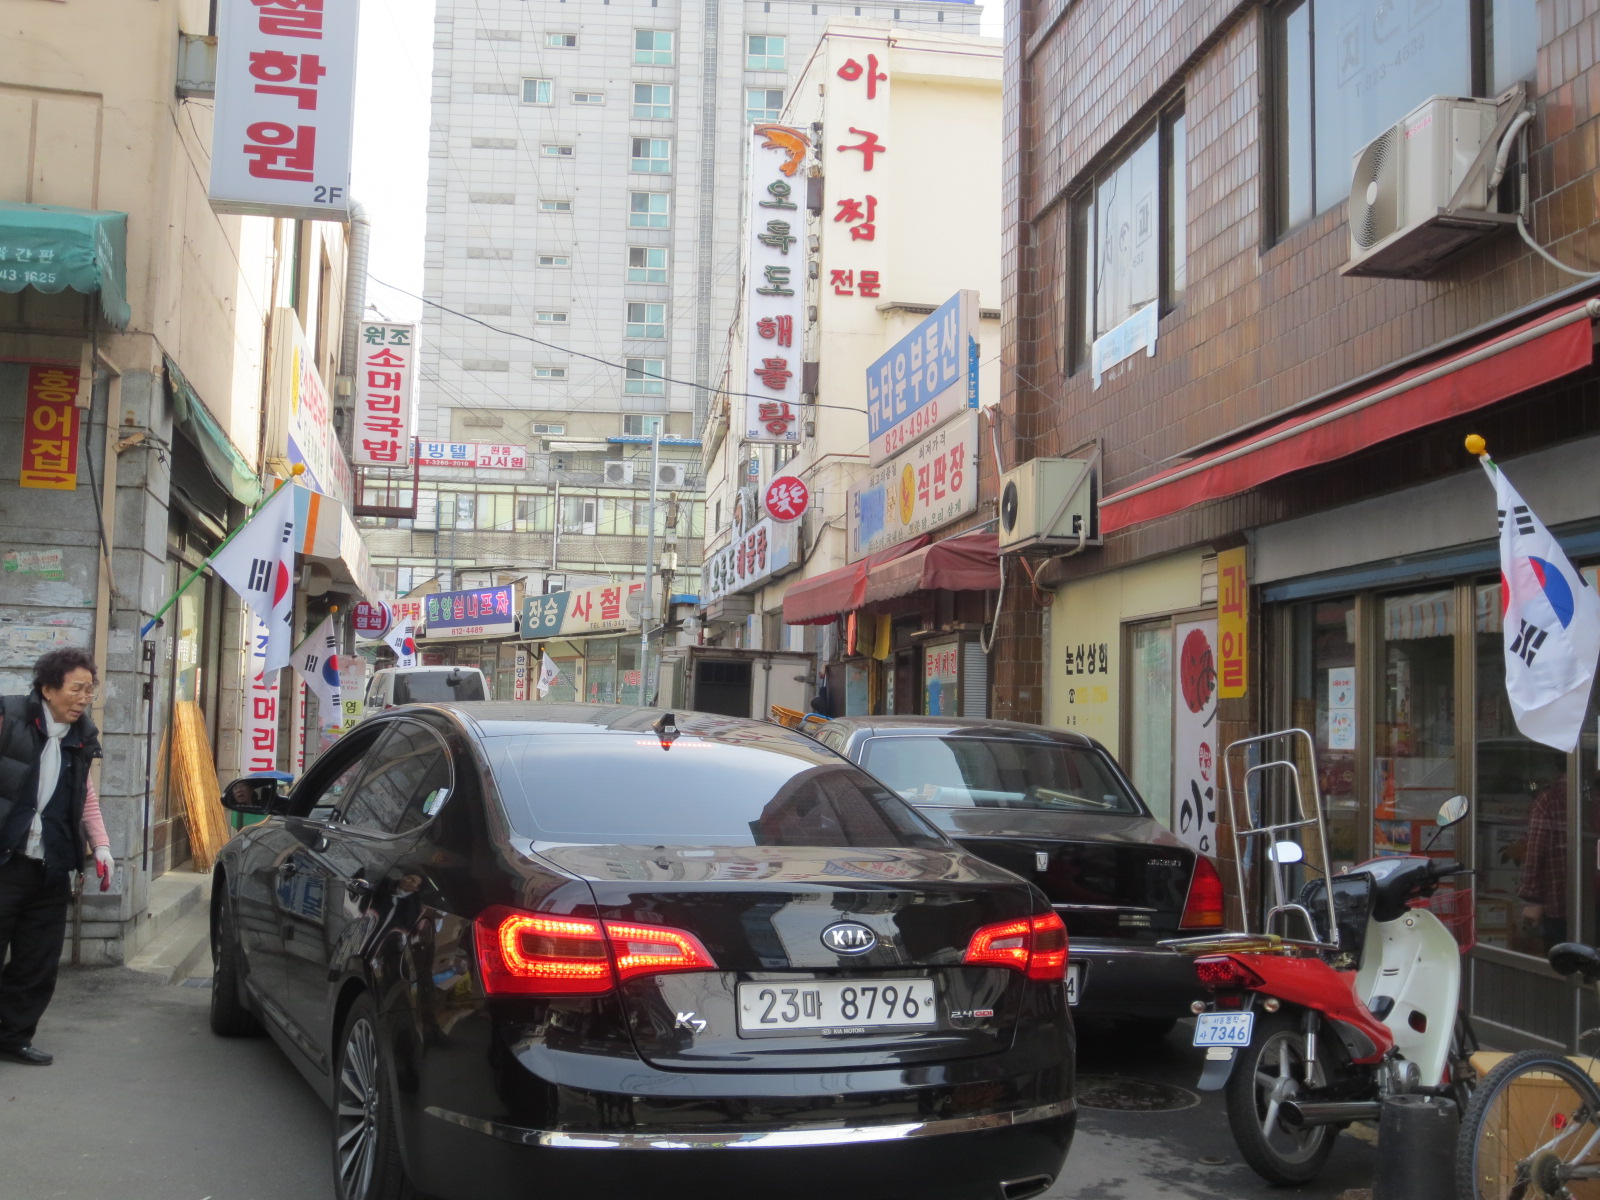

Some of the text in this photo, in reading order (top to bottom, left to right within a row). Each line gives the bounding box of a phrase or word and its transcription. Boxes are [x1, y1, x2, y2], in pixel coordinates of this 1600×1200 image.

[834, 53, 888, 242] 아구찜
[313, 185, 343, 205] 2F
[756, 179, 798, 297] 오륙도
[830, 269, 881, 298] 전문
[363, 325, 411, 346] 원조
[754, 314, 796, 436] 해물탕
[868, 308, 957, 434] 뉴타운부동산
[362, 348, 406, 462] 소머리국밥
[30, 369, 78, 474] 홍어집
[480, 455, 523, 468] 고시원
[490, 446, 511, 456] 원룸
[917, 441, 965, 508] 직판장
[356, 617, 382, 629] 염색
[528, 598, 559, 629] 장승
[1221, 564, 1246, 689] 과일
[451, 626, 484, 635] 812-4489
[1065, 643, 1108, 676] 논산상회
[832, 930, 868, 946] KIA
[759, 985, 920, 1024] 23마 8796
[674, 1012, 707, 1034] K7
[843, 1025, 865, 1034] MOTORS
[1210, 1026, 1246, 1041] 7346
